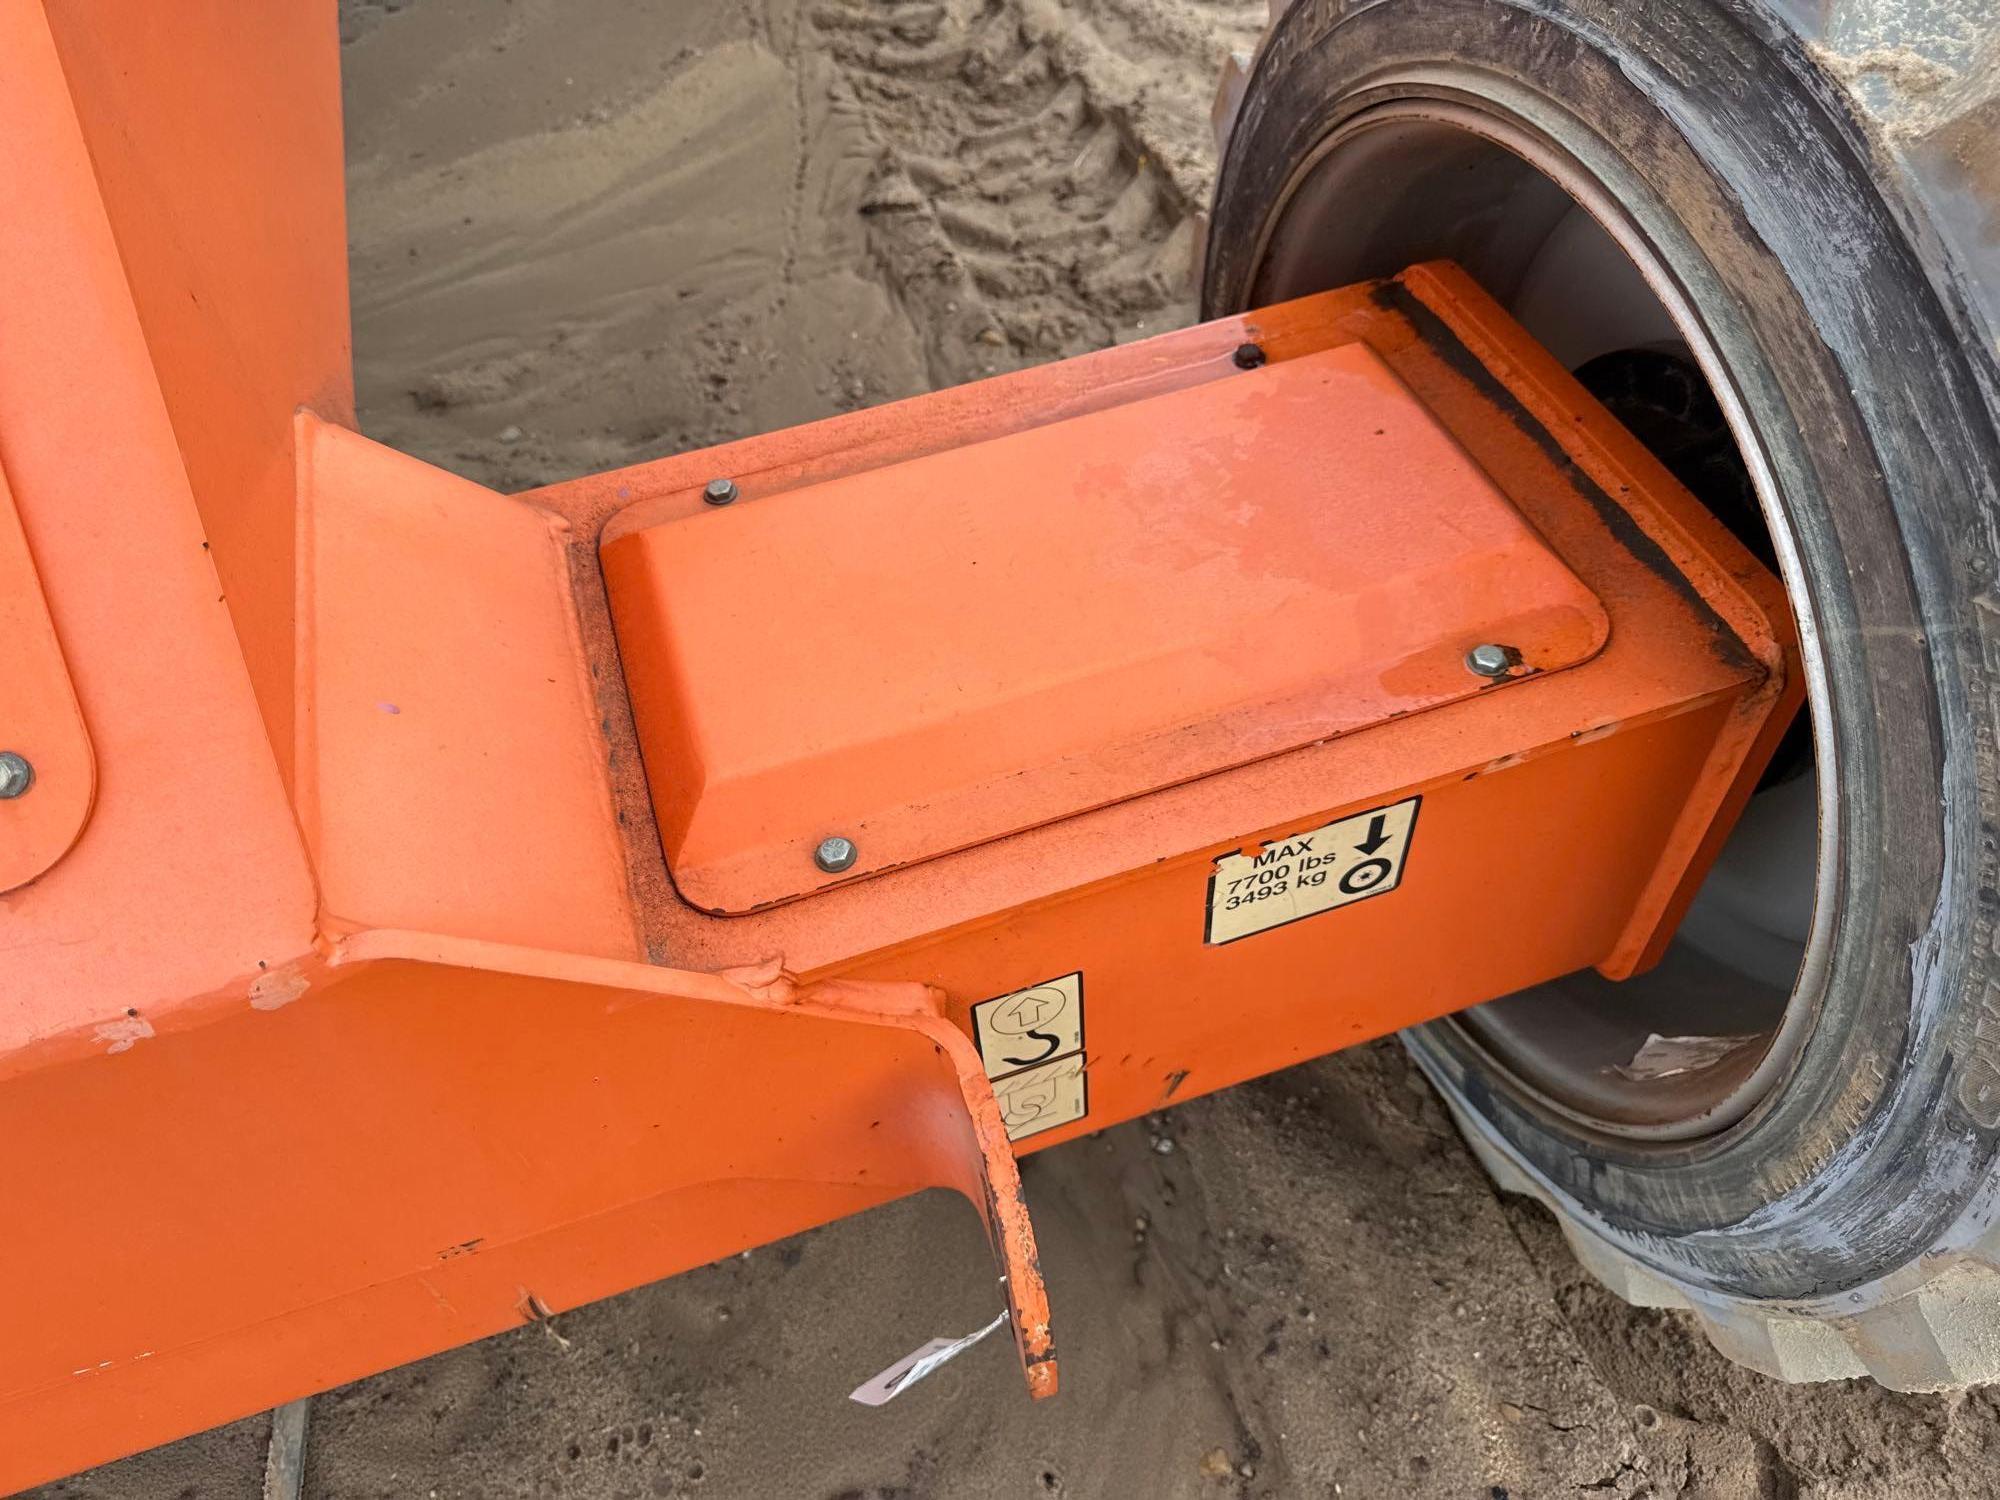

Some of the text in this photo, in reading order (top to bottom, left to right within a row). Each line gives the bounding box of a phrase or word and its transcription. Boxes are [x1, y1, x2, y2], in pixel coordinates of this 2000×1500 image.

[1227, 852, 1337, 895] 7700 lbs
[1253, 837, 1315, 869] MAX
[1225, 870, 1327, 911] 3493 kg
